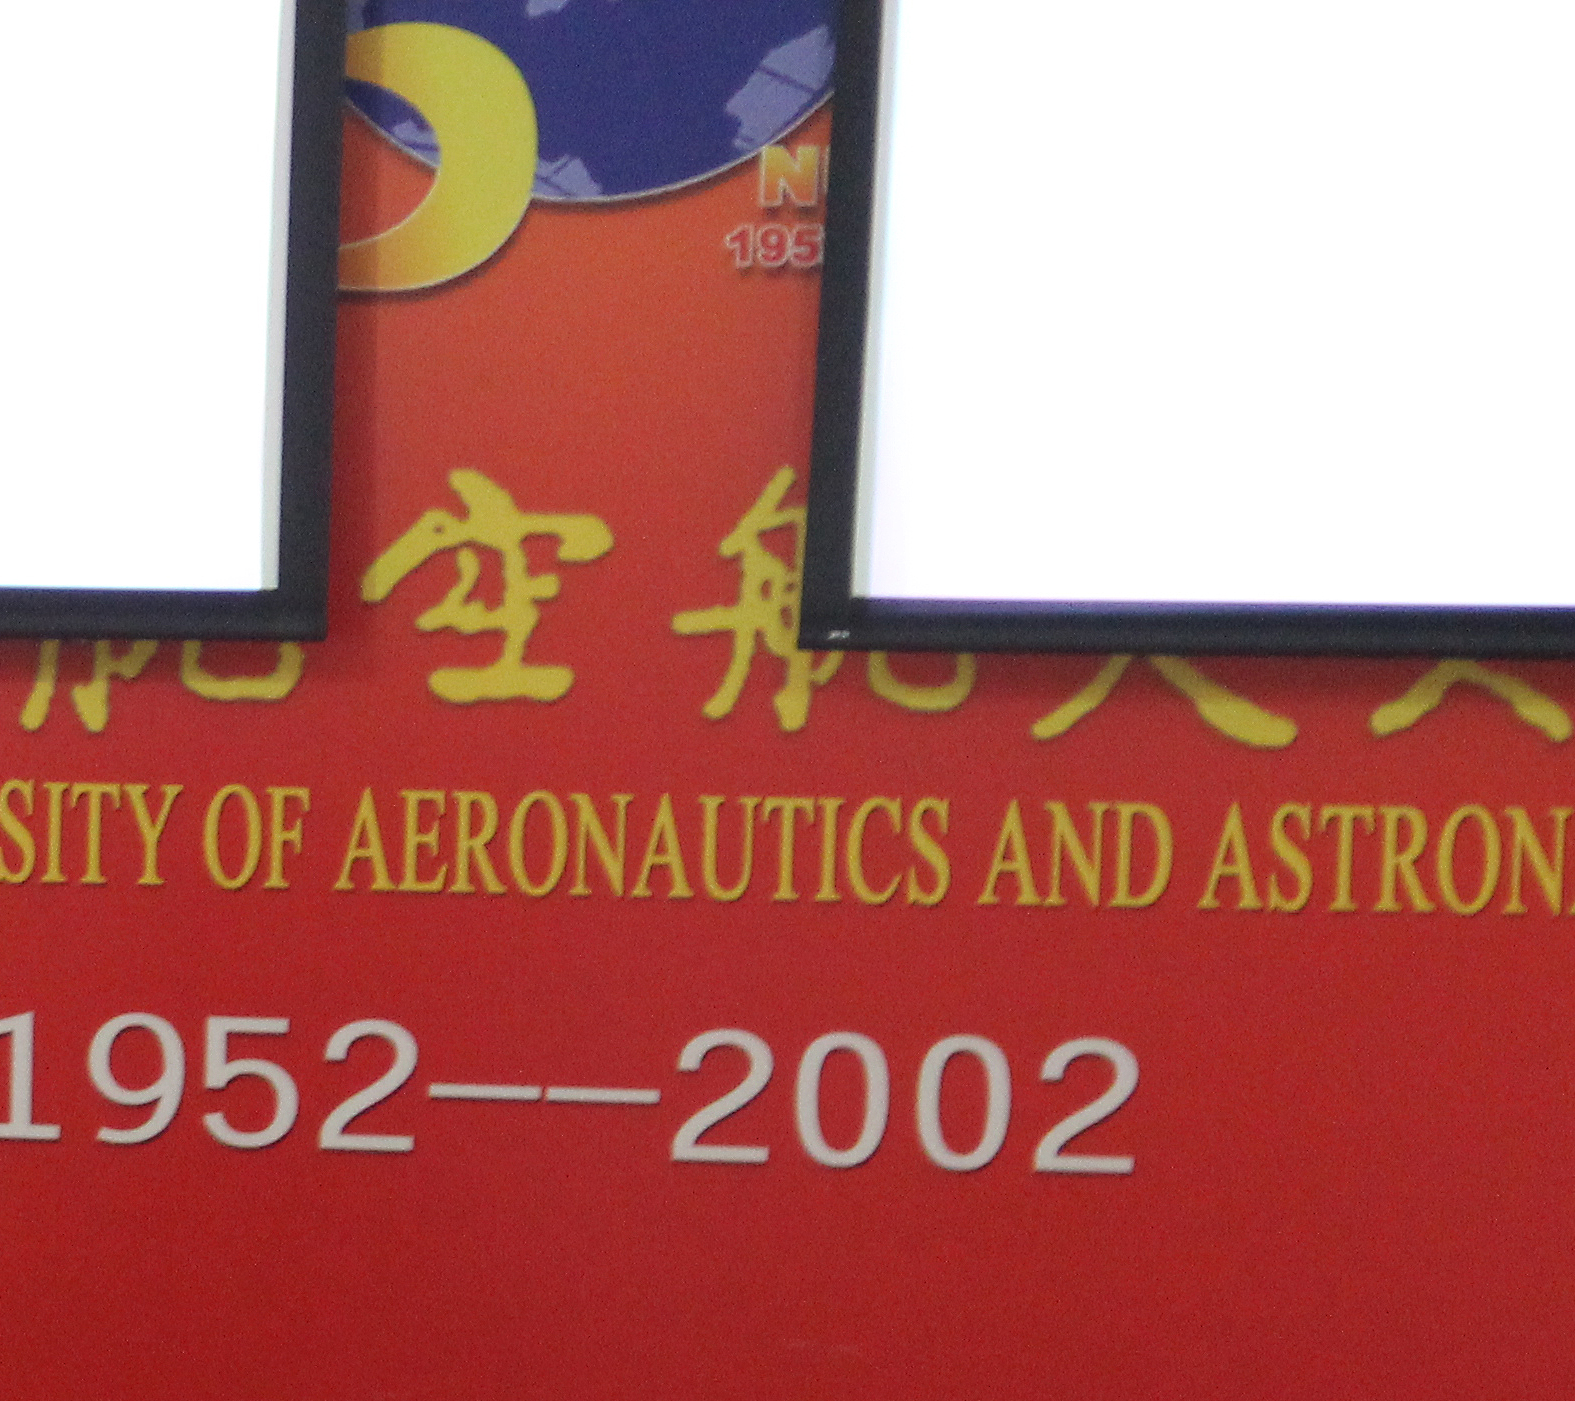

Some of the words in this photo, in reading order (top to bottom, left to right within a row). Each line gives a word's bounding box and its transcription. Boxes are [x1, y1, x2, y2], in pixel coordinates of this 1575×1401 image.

[202, 783, 311, 890] OF
[333, 788, 951, 905] AERONAUTICS
[976, 799, 1174, 908] AND
[1196, 802, 1575, 916] ASTRON
